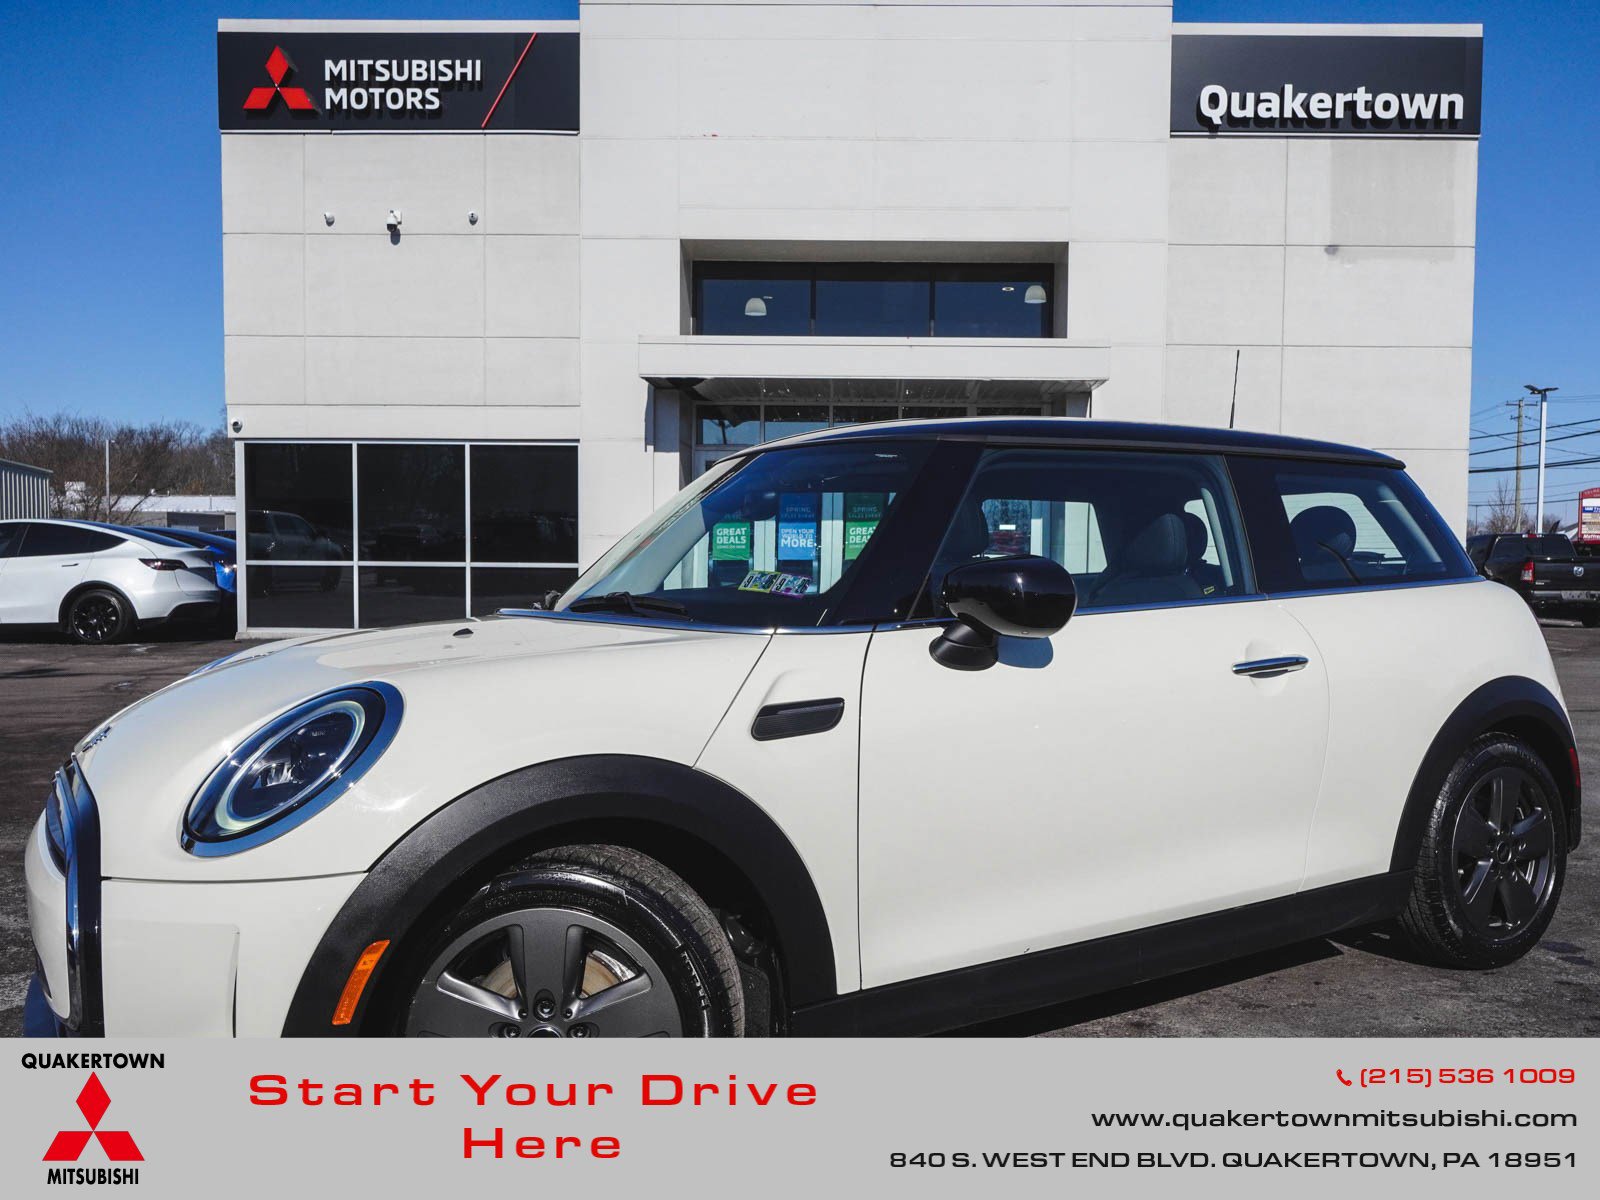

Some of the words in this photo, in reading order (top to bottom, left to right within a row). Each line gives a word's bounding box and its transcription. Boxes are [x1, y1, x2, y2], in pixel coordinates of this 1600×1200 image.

[325, 59, 482, 82] MITSUBISHI
[325, 87, 440, 110] MOTORS
[1199, 84, 1464, 125] Quakertown
[716, 528, 747, 536] GREAT
[849, 526, 877, 535] GREA
[716, 536, 746, 544] DEALS
[780, 536, 814, 548] MORE
[849, 535, 871, 544] DEA
